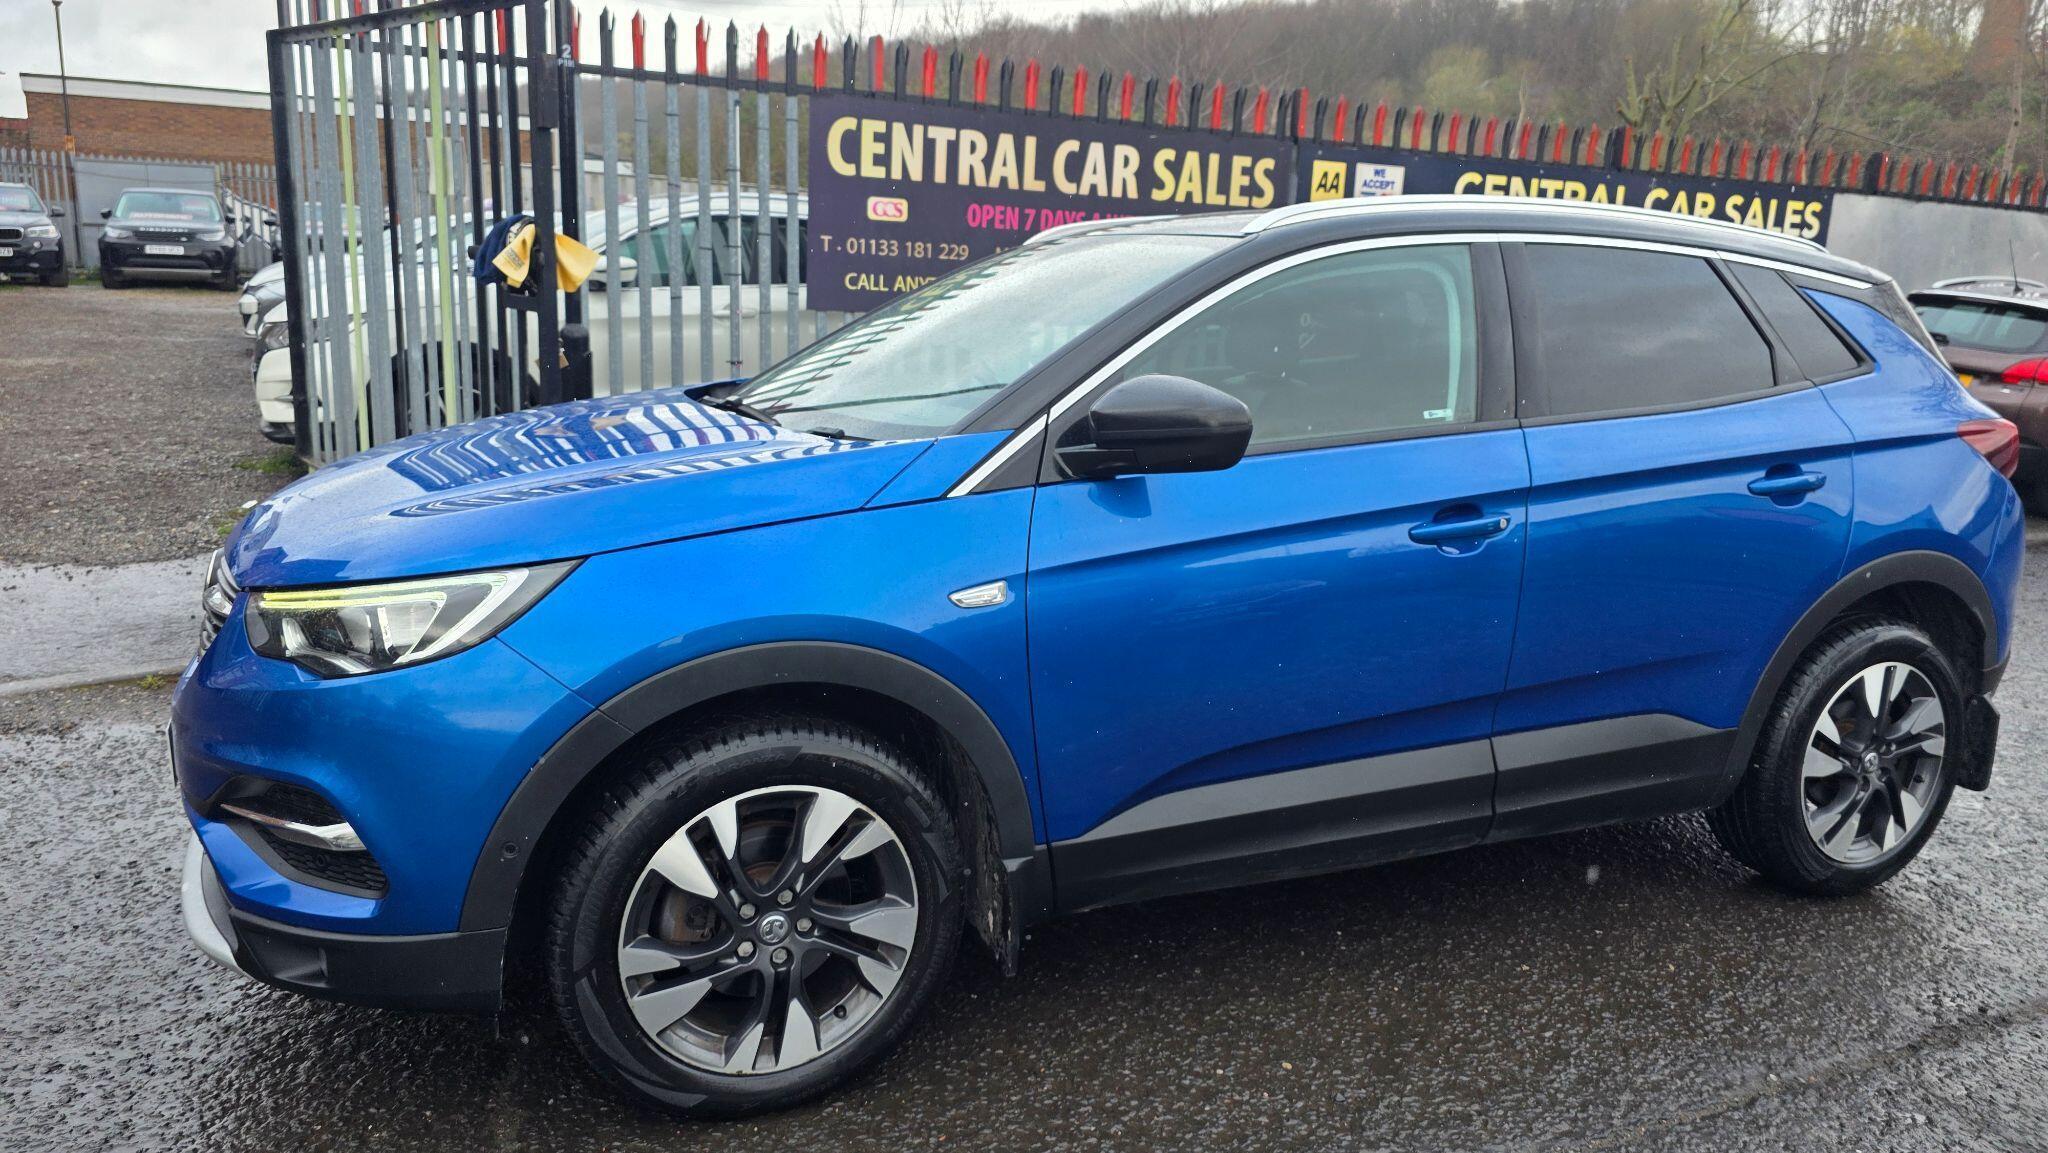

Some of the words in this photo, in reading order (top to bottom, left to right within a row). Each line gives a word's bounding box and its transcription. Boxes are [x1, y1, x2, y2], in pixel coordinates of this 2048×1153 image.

[827, 116, 1046, 192] CENTRAL
[1052, 139, 1139, 199] CAR
[1151, 147, 1275, 208] SALES
[1373, 168, 1386, 178] WE
[1316, 171, 1340, 193] AA
[1362, 179, 1395, 190] ACCEPT
[967, 203, 1019, 231] OPEN
[1024, 208, 1037, 232] 7
[1725, 194, 1823, 240] SALES
[846, 237, 899, 257] 01133
[905, 241, 932, 259] 181
[938, 243, 969, 261] 229
[844, 272, 889, 292] CALL
